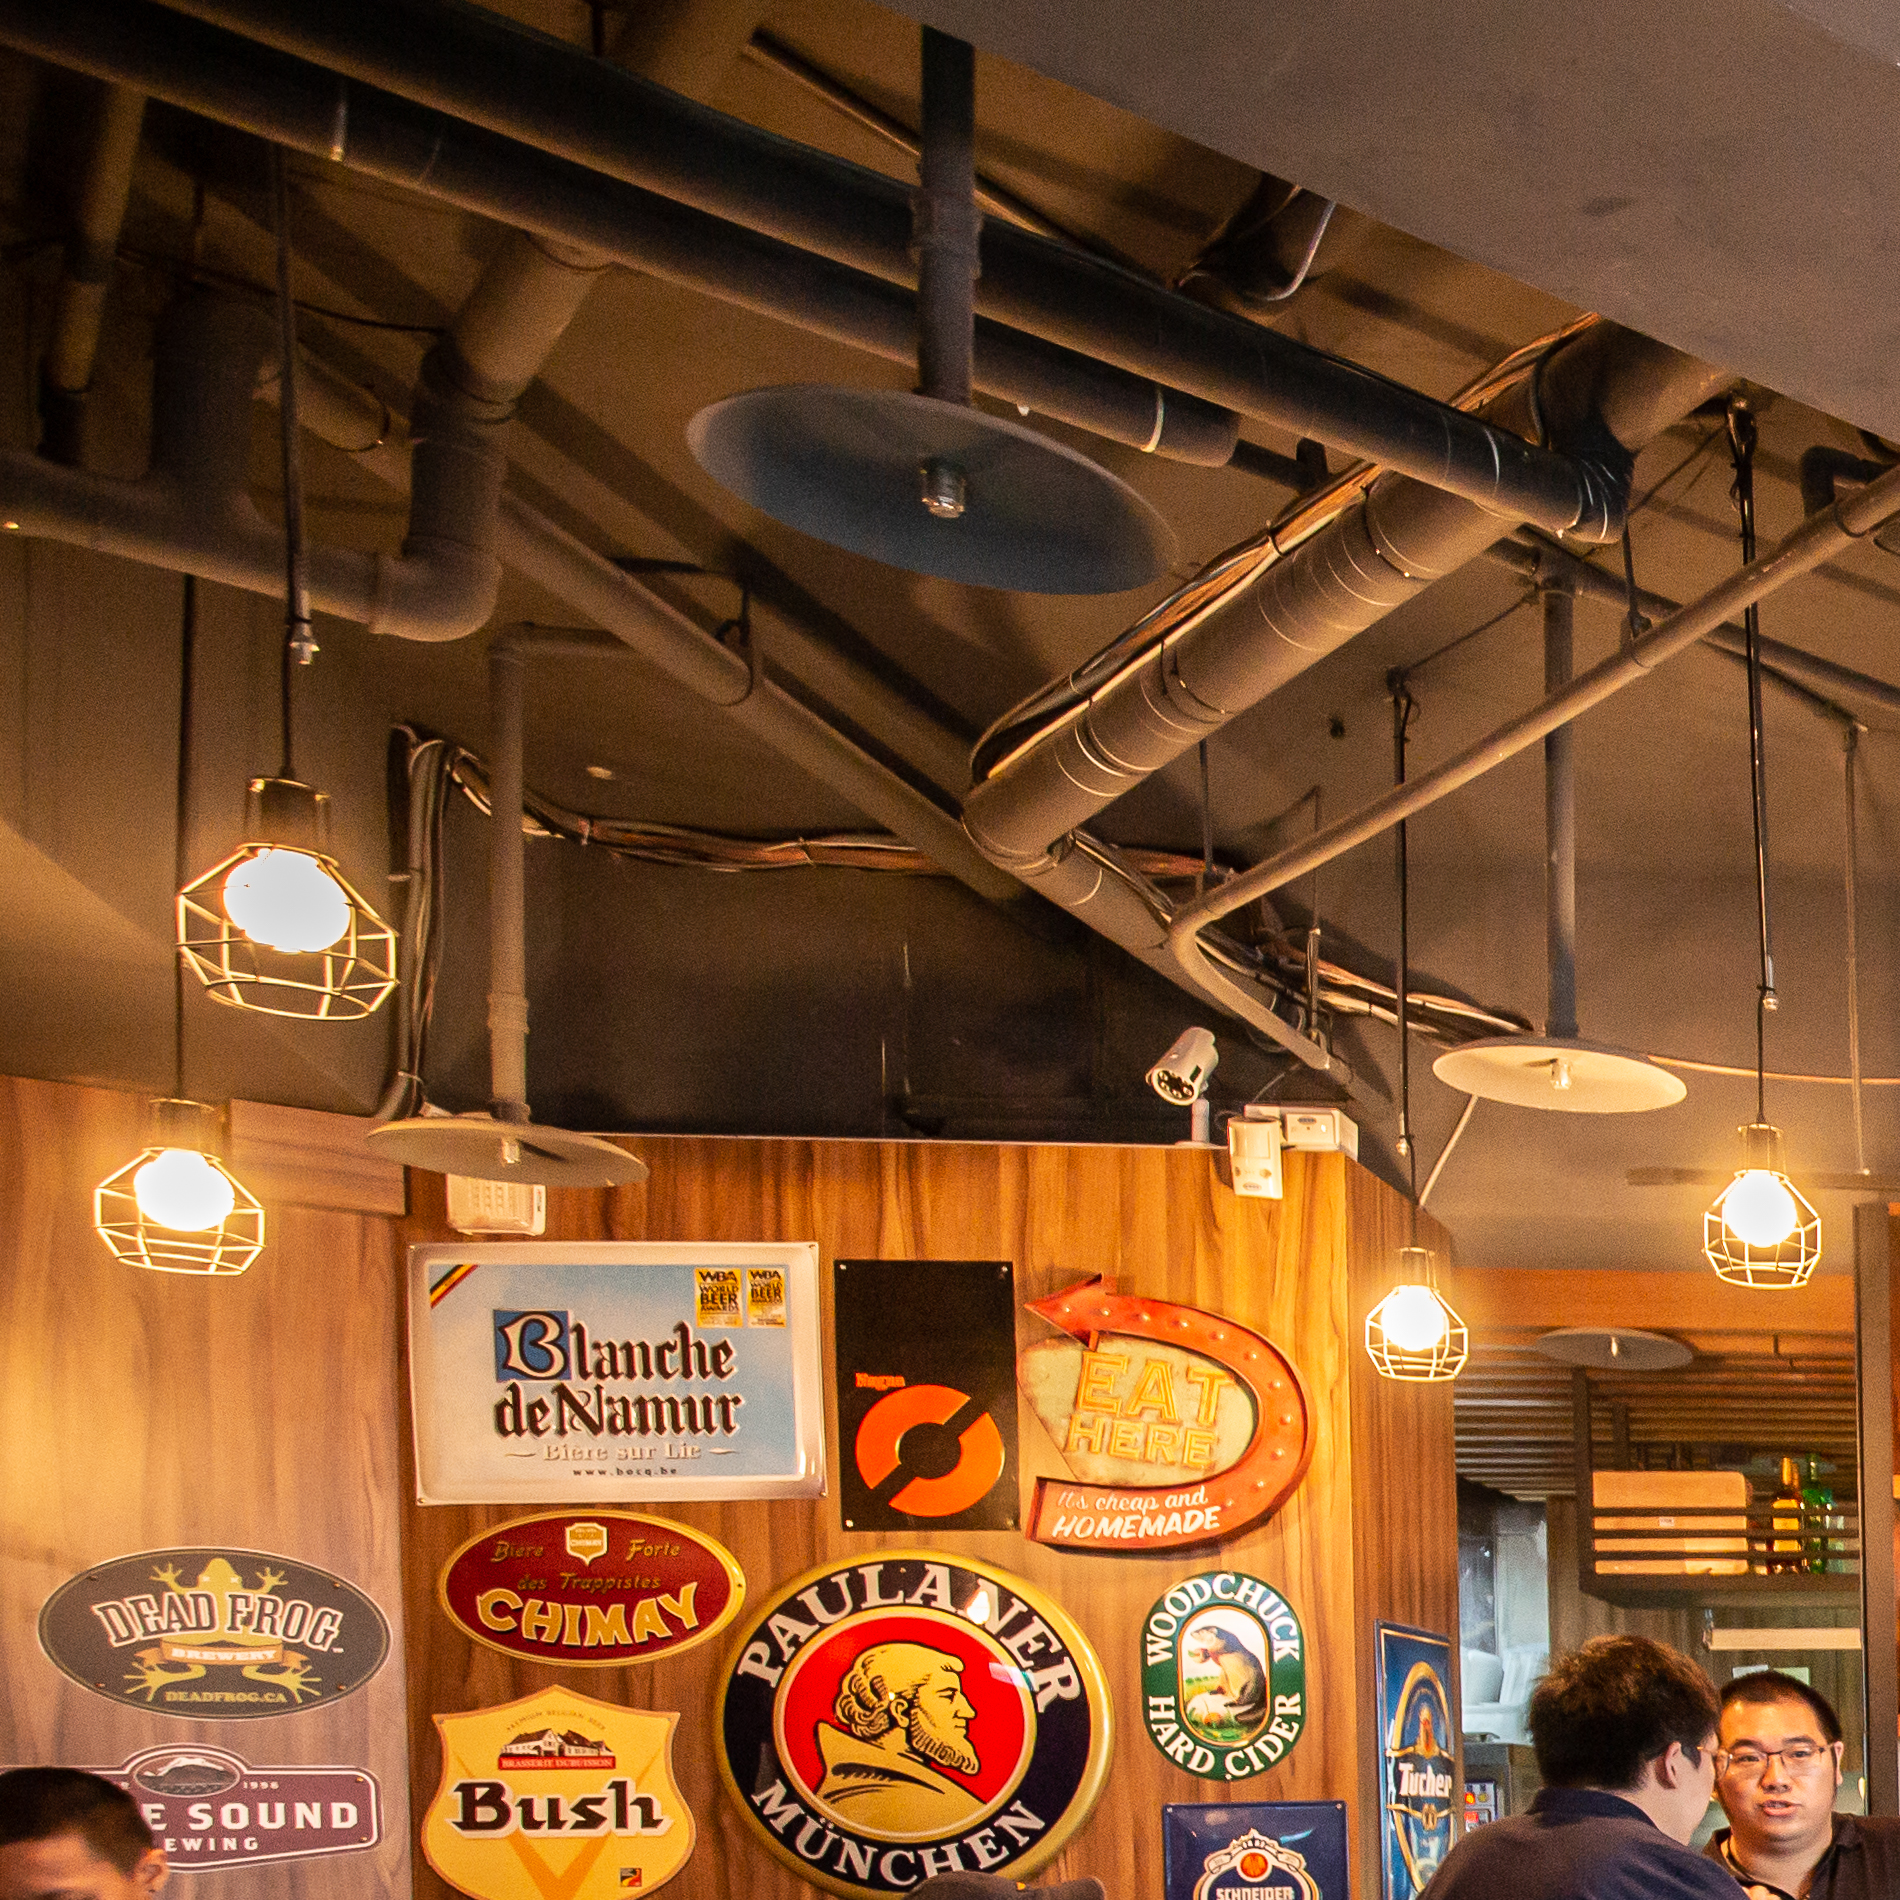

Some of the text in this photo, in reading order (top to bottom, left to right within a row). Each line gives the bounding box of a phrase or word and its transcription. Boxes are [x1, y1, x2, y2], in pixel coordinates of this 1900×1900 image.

[700, 1292, 738, 1304] BEER
[497, 1311, 738, 1381] Blanche
[494, 1381, 744, 1438] de Namur
[1077, 1350, 1236, 1427] EAT
[617, 1447, 656, 1461] sur
[1066, 1415, 1219, 1468] HERE
[1095, 1494, 1159, 1516] cheap
[1164, 1485, 1209, 1509] and
[1051, 1505, 1222, 1539] HOMEMADE
[627, 1538, 682, 1562] Forte
[516, 1571, 662, 1594] des Trappistes
[91, 1591, 344, 1651] DEAD FROG
[476, 1581, 699, 1646] CHIMAY
[1146, 1573, 1300, 1667] WOODCHUCK
[171, 1647, 278, 1661] BREWERY
[737, 1563, 1082, 1714] PAULANER
[165, 1691, 288, 1703] DEADFROG.CA
[1148, 1692, 1302, 1778] HARD CIDER
[1398, 1763, 1453, 1797] Tucher
[188, 1802, 358, 1831] SOUND
[451, 1780, 665, 1831] Bush
[164, 1837, 260, 1853] EWING
[751, 1778, 1047, 1887] MÜNCHEN
